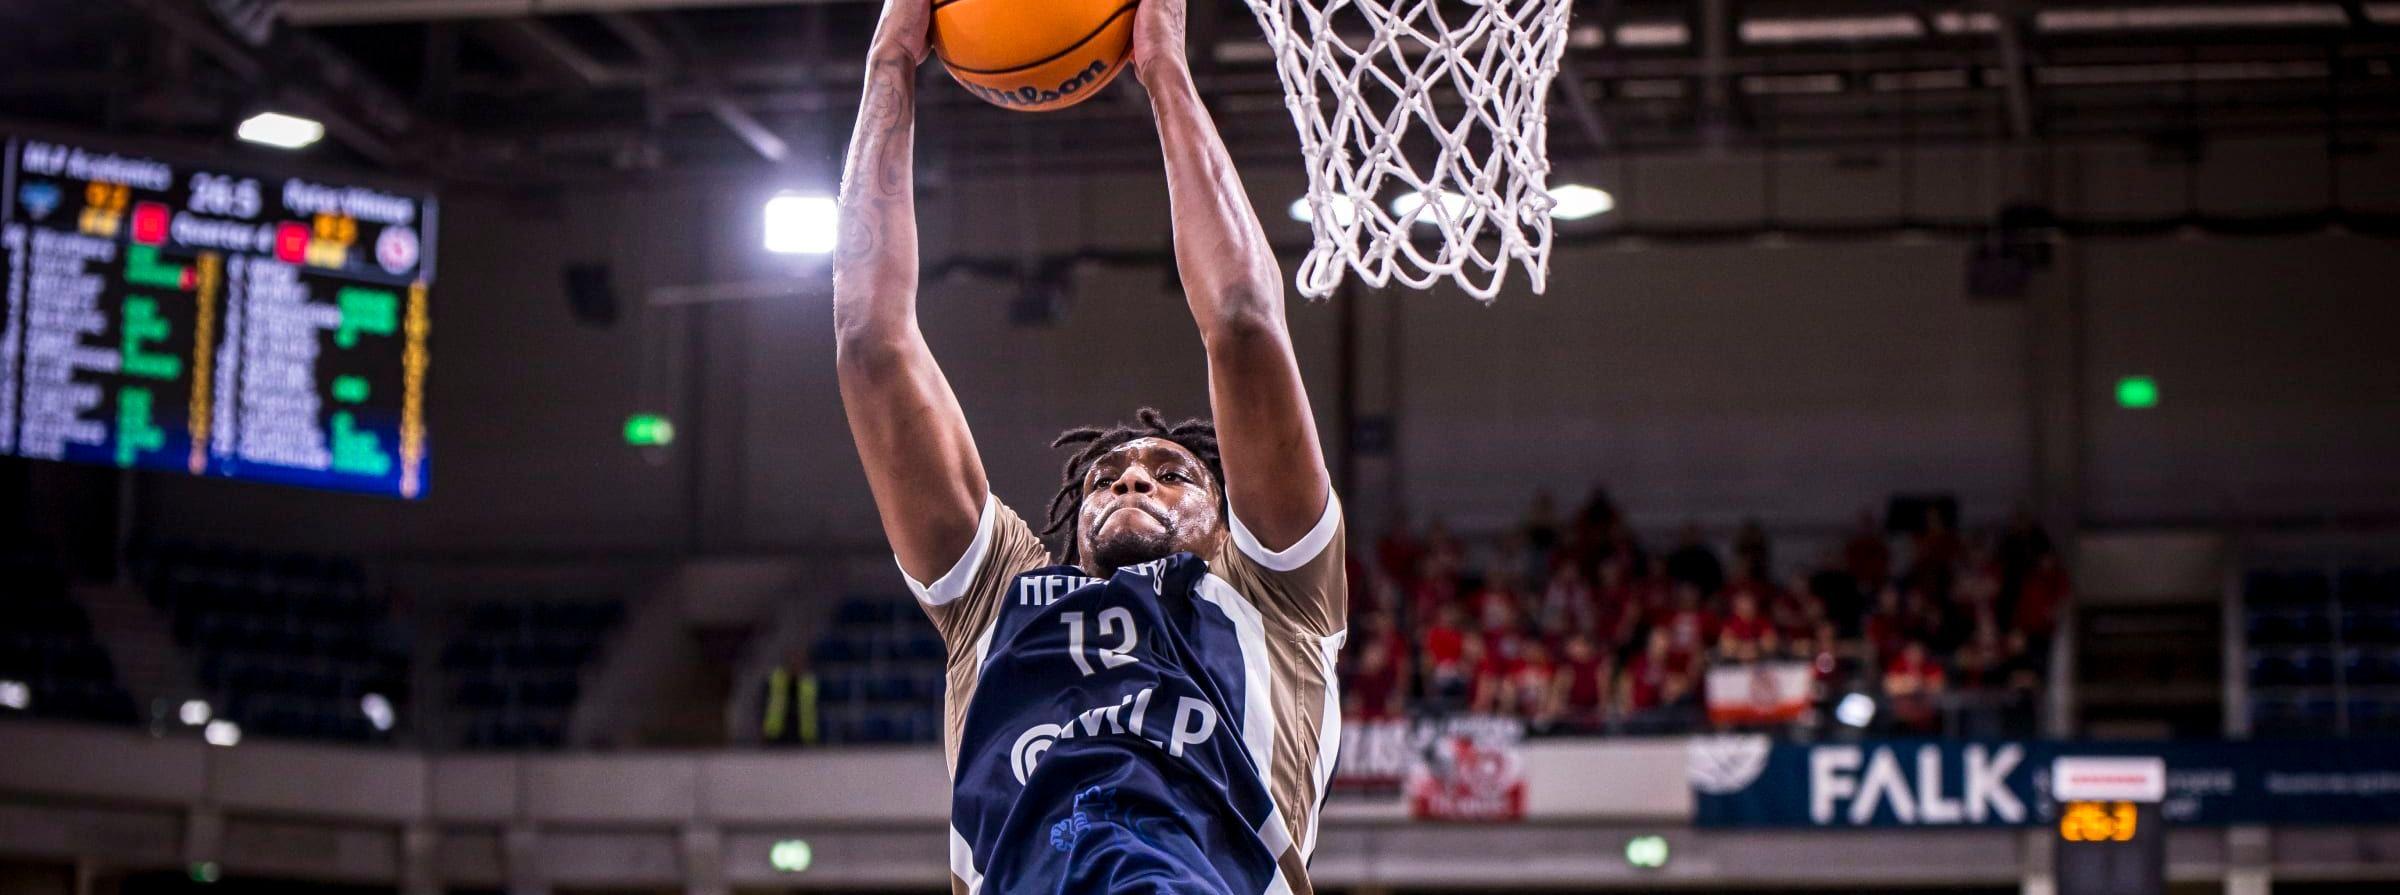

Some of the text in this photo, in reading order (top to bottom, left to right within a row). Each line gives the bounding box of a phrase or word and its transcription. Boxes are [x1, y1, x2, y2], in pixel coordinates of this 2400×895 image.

[1060, 606, 1139, 676] 12
[1061, 688, 1217, 758] MLP
[1809, 744, 2027, 824] FALK
